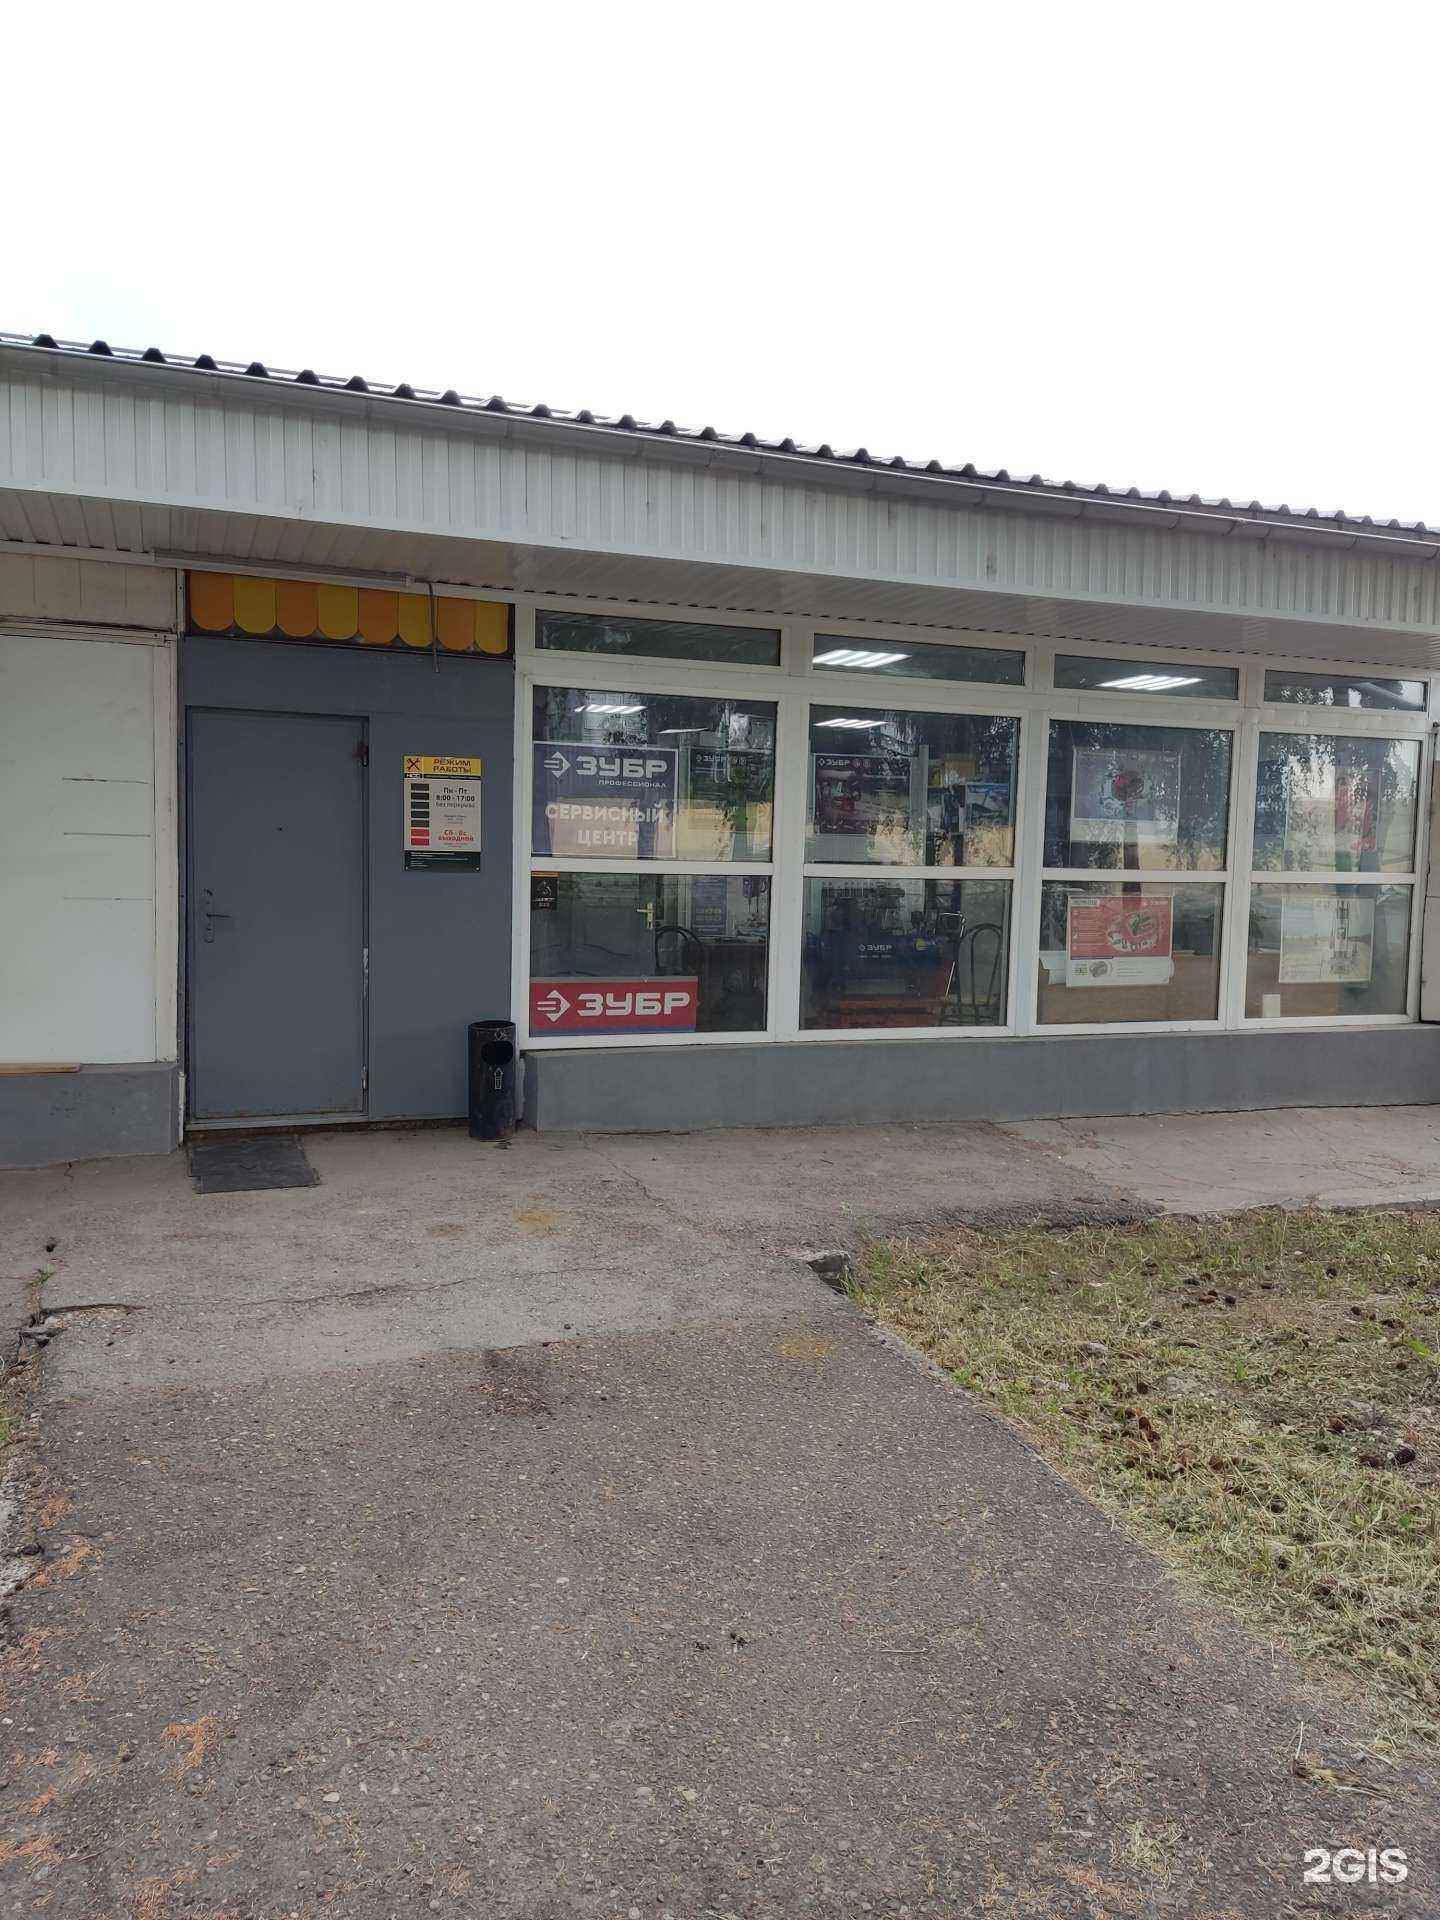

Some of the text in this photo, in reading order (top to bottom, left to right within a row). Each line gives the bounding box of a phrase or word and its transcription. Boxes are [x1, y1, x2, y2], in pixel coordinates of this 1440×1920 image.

[433, 758, 471, 766] РЕЖИМ
[575, 755, 667, 778] ЗУБР
[598, 779, 667, 788] ПРОФЕССИОНАЛ
[545, 800, 665, 823] СЕРВИСНЫЙ
[577, 830, 638, 847] ЦЕНТР
[576, 992, 690, 1017] ЗУБР
